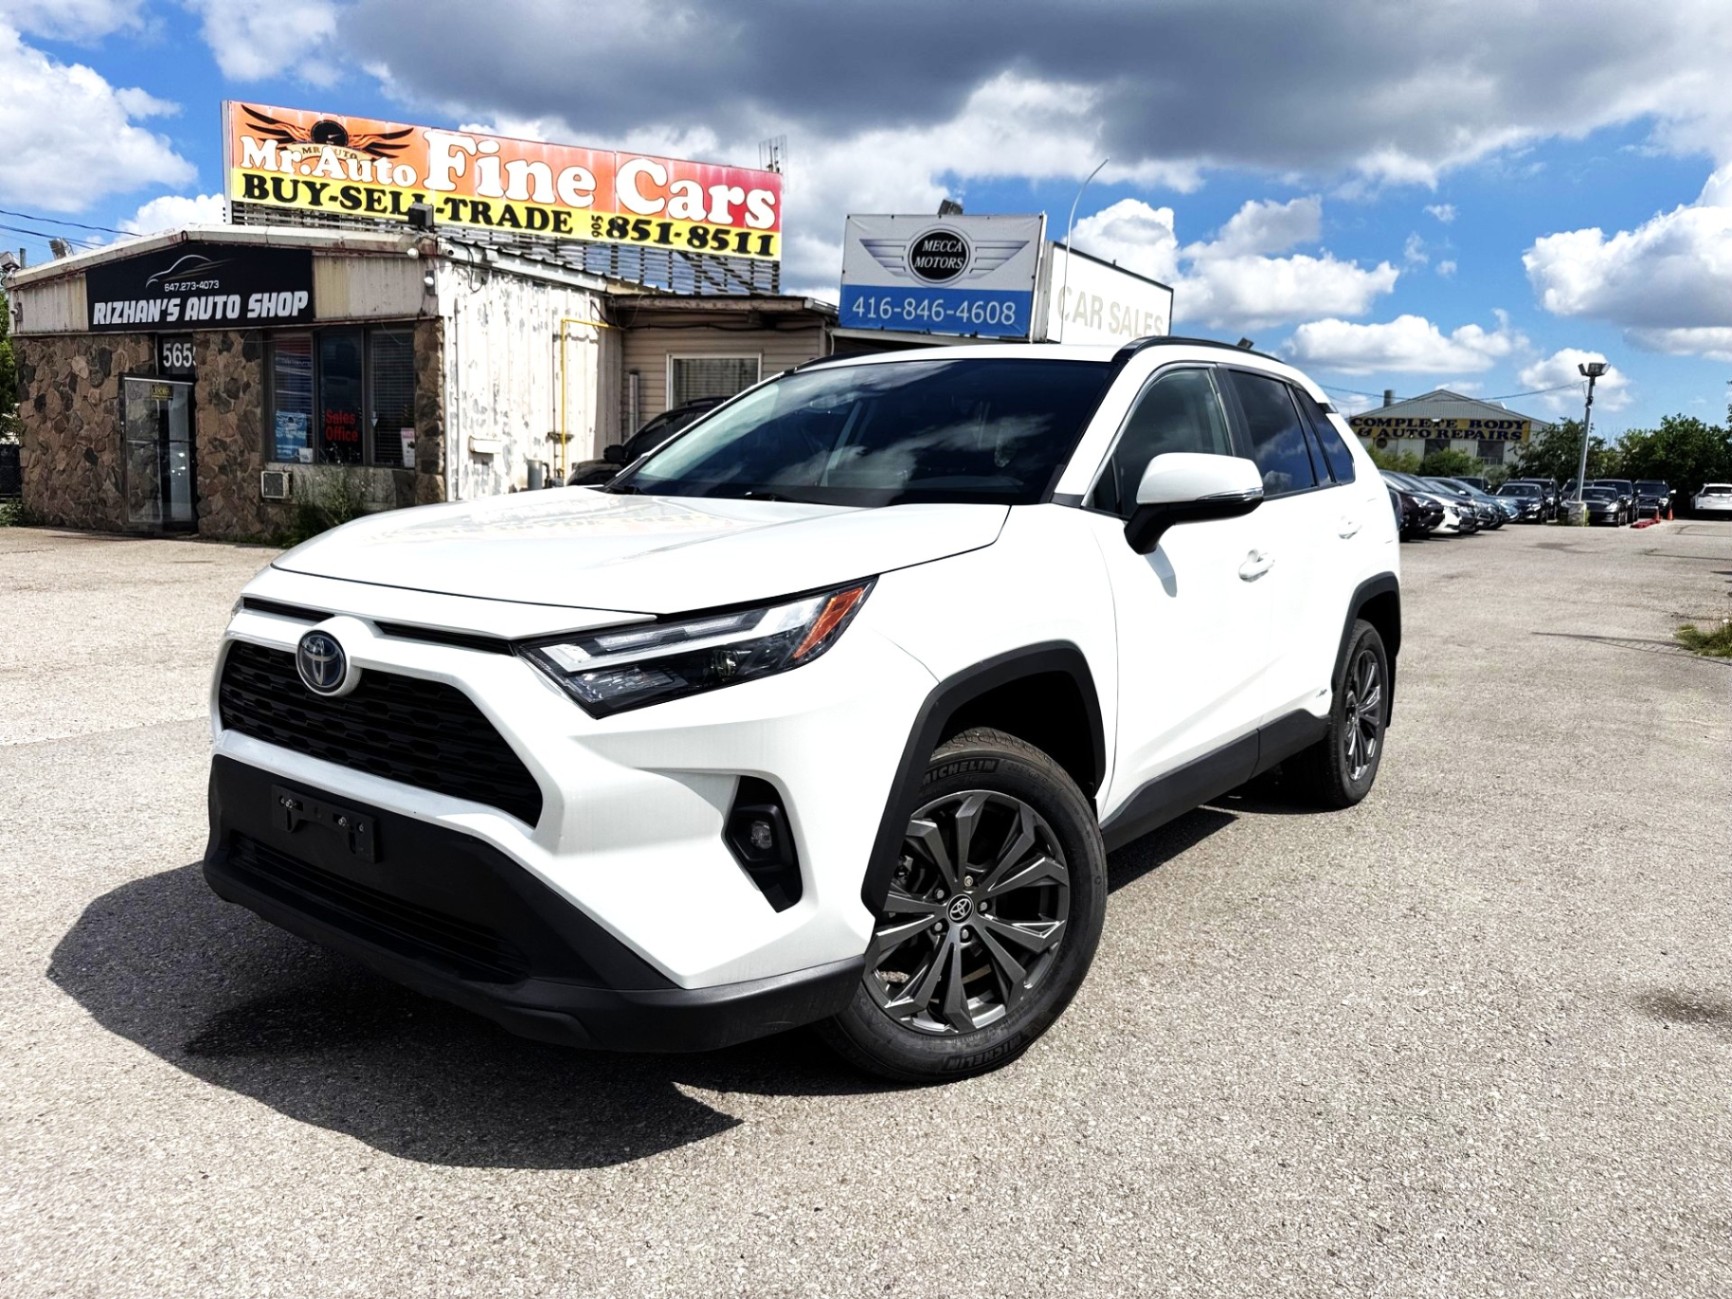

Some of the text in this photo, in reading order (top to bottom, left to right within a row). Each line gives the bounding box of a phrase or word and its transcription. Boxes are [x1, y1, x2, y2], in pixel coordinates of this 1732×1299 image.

[423, 130, 597, 208] Fine
[615, 158, 777, 229] Cars
[591, 214, 774, 256] 905 851-8511
[914, 240, 964, 270] MECCA MOTORS
[93, 290, 309, 325] RIZHAN'S AUTO SHOP
[852, 296, 1016, 325] 416-846-4608
[1057, 286, 1164, 338] CAR SALES
[326, 409, 356, 425] Sales
[1350, 417, 1529, 430] COMPLETE BODY
[325, 426, 359, 442] Office
[1357, 428, 1523, 441] & AUTO REPAIRS
